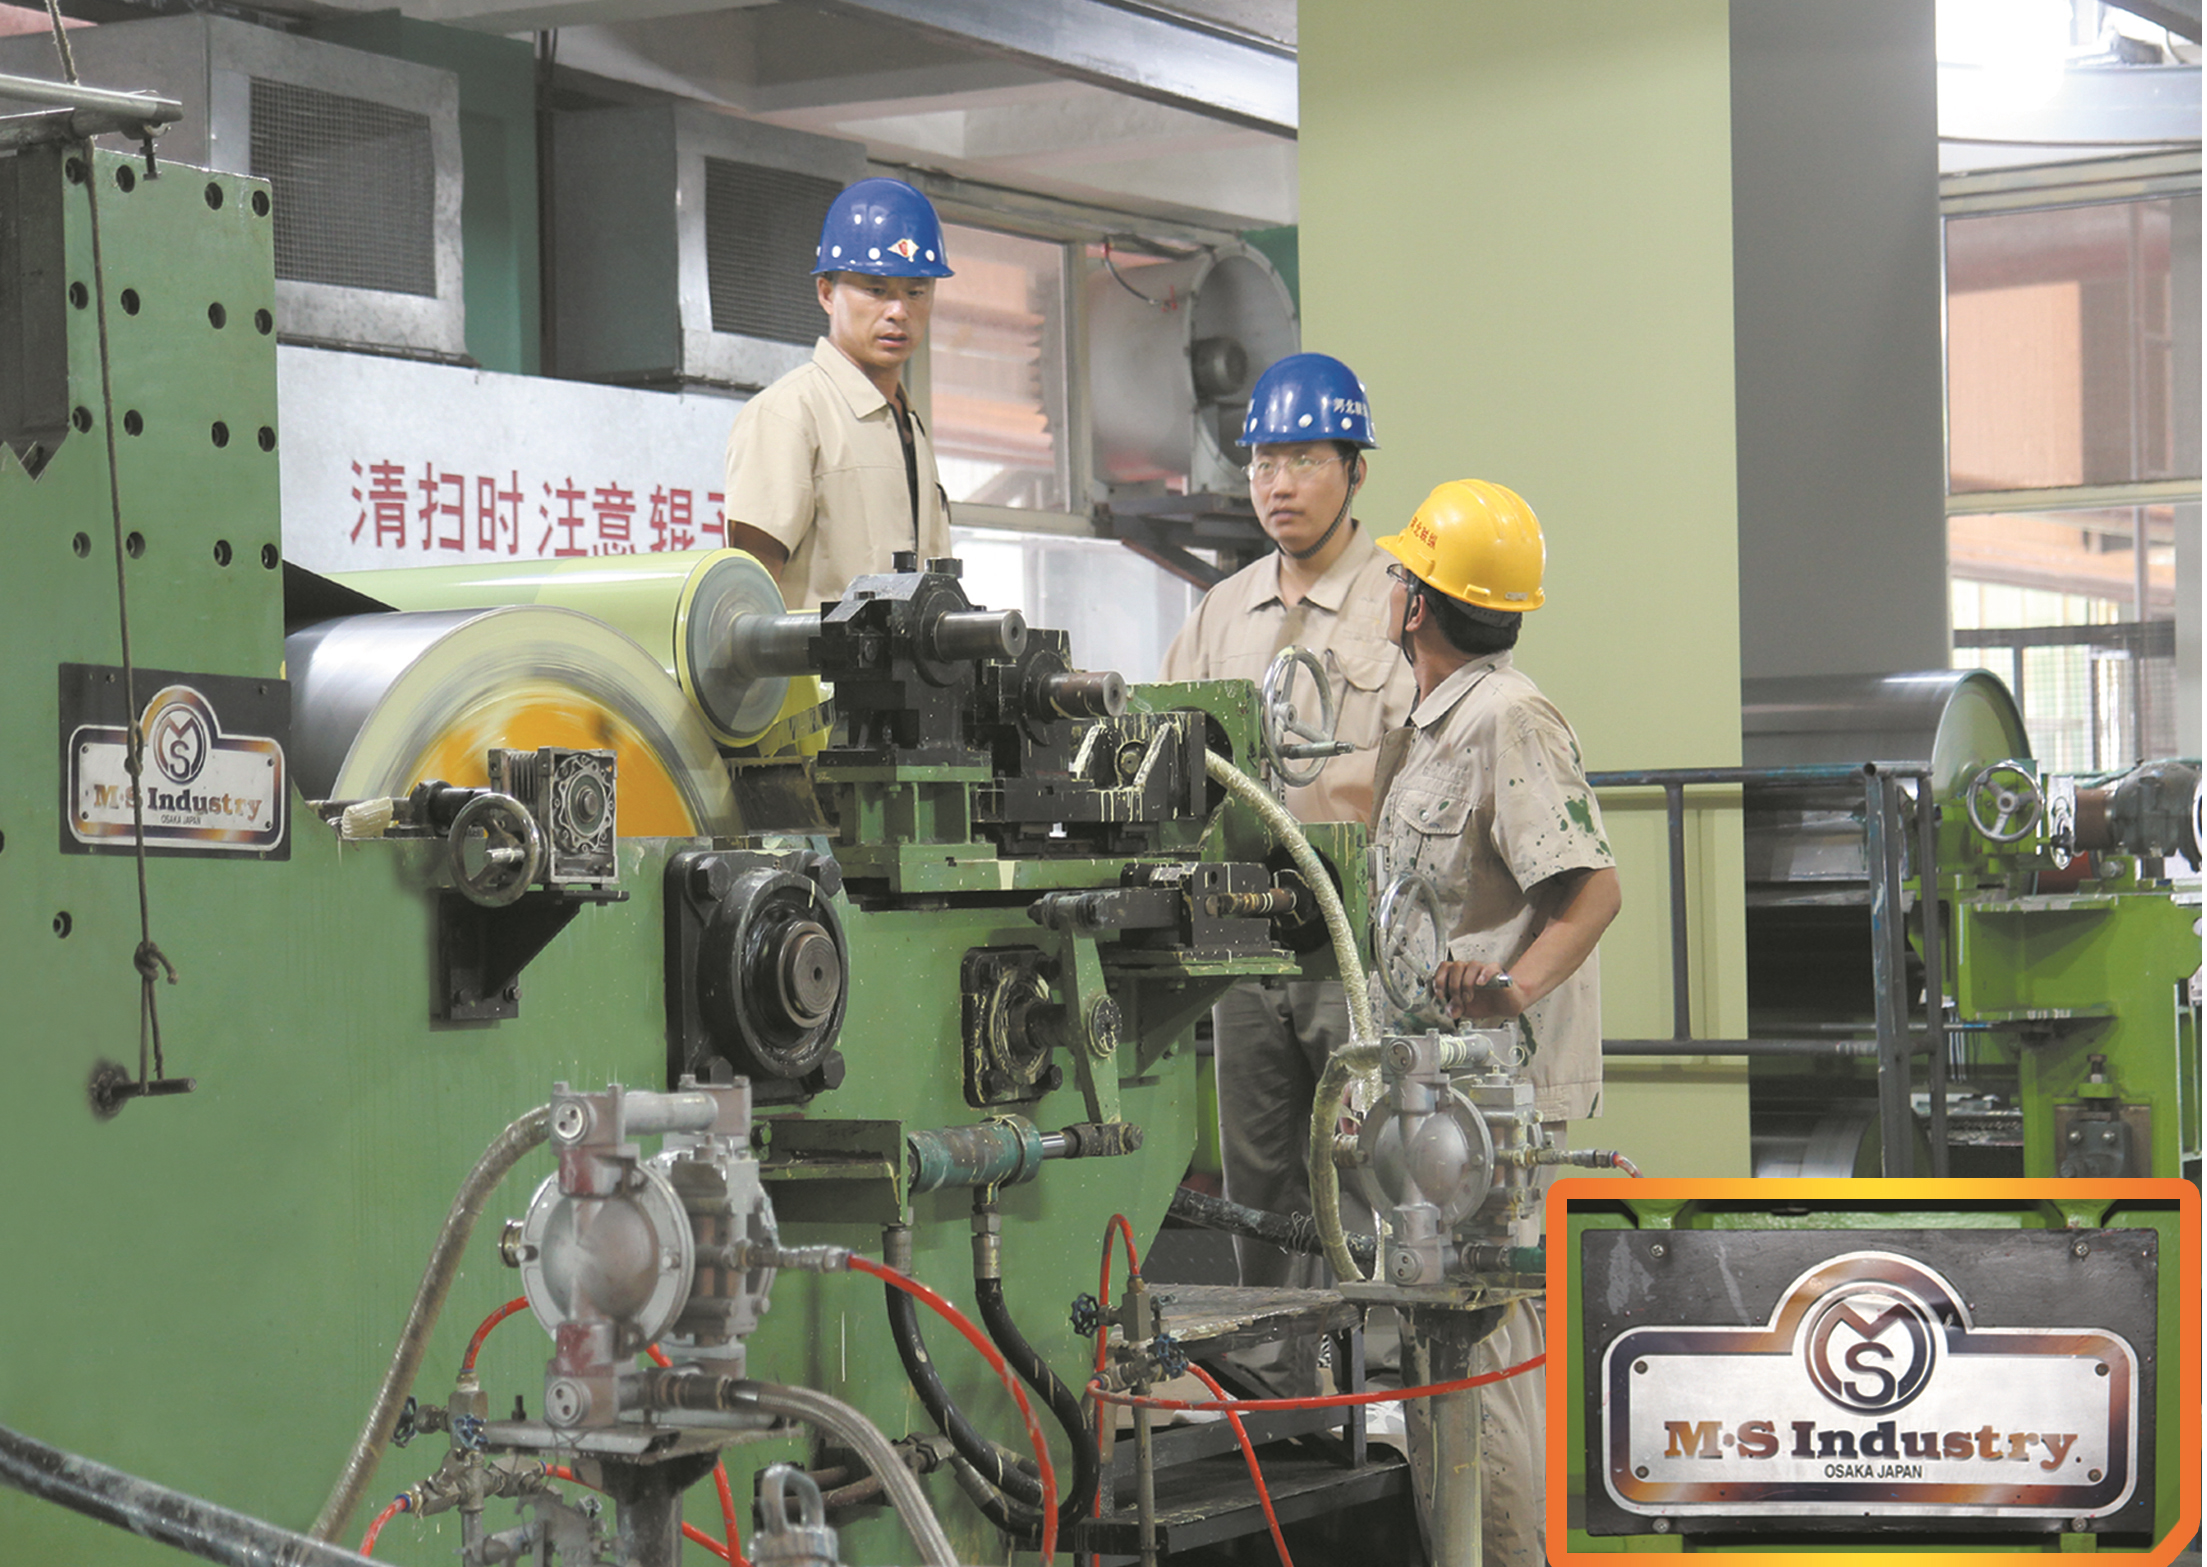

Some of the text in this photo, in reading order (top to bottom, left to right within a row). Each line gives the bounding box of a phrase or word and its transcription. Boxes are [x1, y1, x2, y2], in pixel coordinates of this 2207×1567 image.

[147, 787, 262, 821] Industry
[161, 814, 202, 825] OSAKA JAPAN
[1791, 1420, 2078, 1472] Industry
[1824, 1464, 1923, 1479] OSAKA JAPAN
